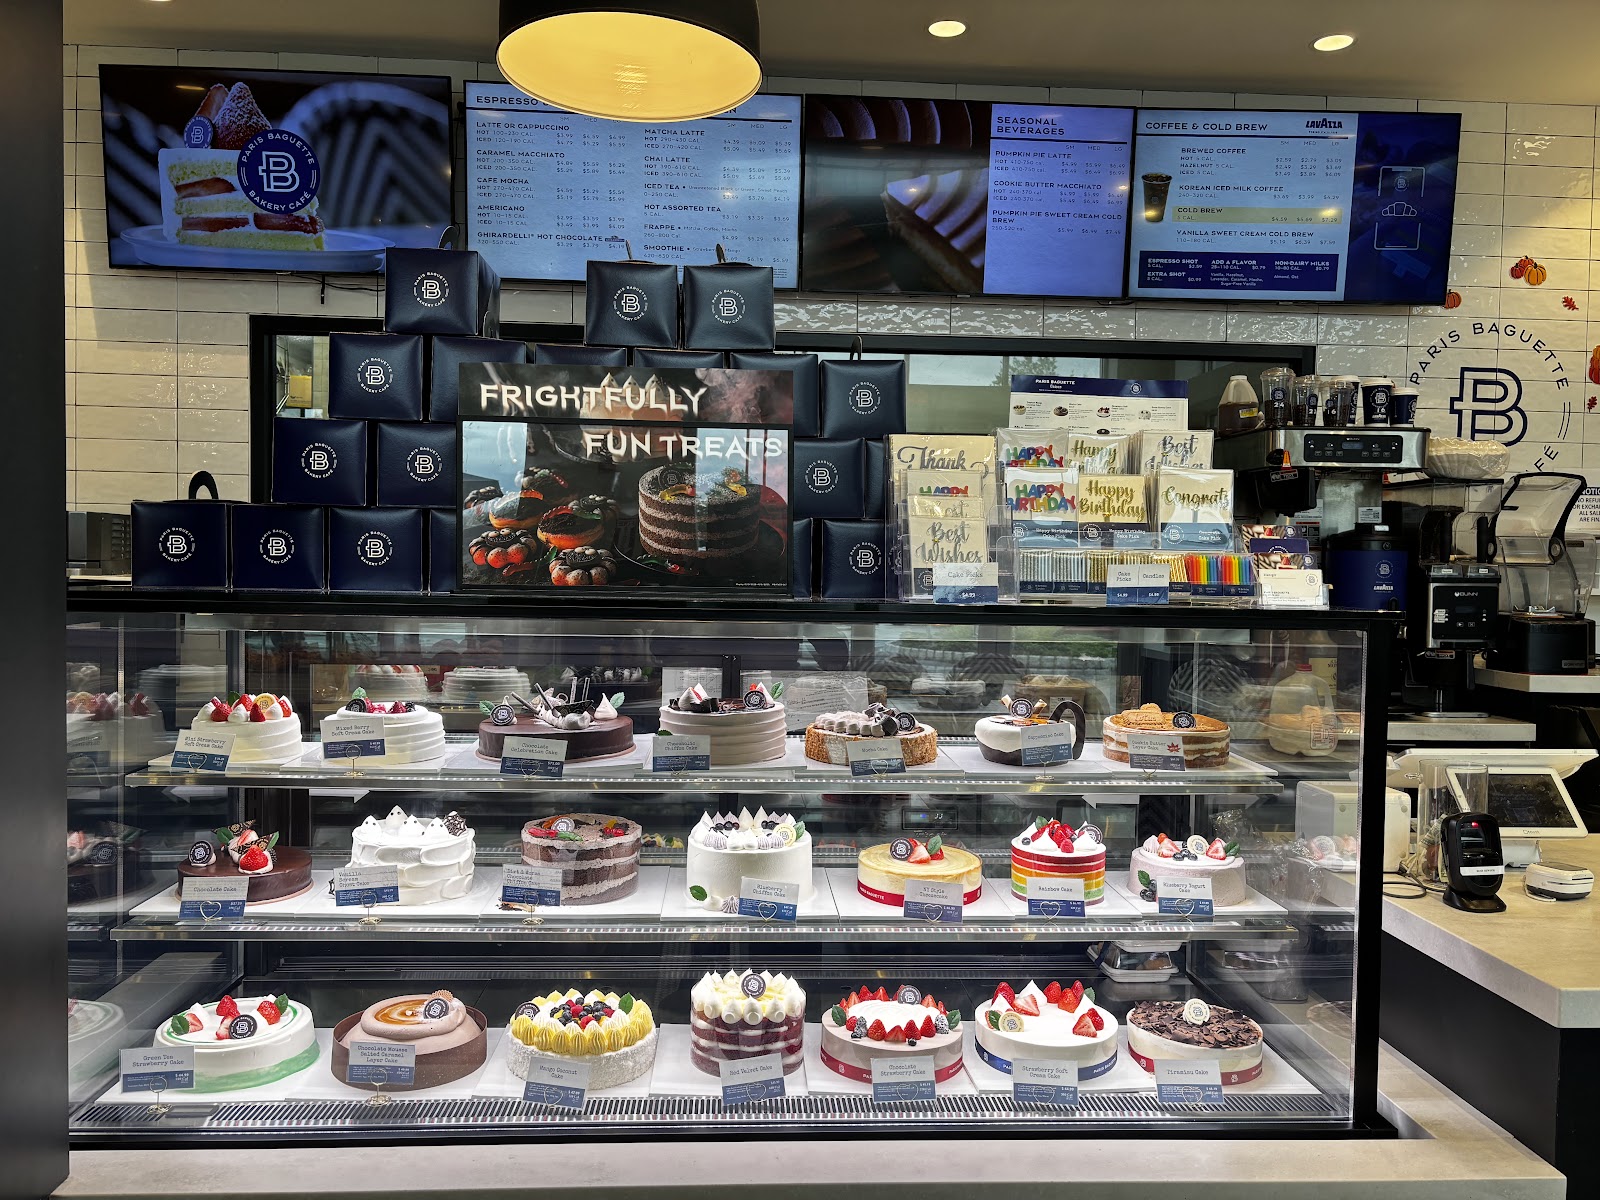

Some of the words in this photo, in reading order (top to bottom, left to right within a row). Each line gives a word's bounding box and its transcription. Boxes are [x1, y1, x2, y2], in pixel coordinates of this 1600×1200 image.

[476, 96, 539, 106] ESPRESSO
[997, 116, 1057, 126] SEASONAL
[1145, 122, 1188, 130] COFFEE
[1202, 123, 1232, 131] COLD
[1236, 123, 1268, 131] BREW
[1305, 117, 1343, 129] LAVAZZA
[997, 126, 1065, 136] BEVERAGES
[241, 136, 264, 163] PARIS
[267, 132, 316, 165] BAGUETTE
[248, 190, 286, 212] BAKERY
[288, 191, 311, 210] CAFÉ
[555, 234, 603, 242] CHOCOLATE
[1409, 330, 1461, 385] PARIS
[1472, 322, 1569, 390] BAGUETTE
[480, 383, 708, 416] FRIGHTFULLY
[583, 432, 651, 459] FUN
[658, 435, 783, 462] TREATS
[1006, 444, 1054, 460] HAPPY
[1070, 440, 1120, 464] Happy
[1158, 435, 1199, 458] Best
[897, 446, 967, 470] Thank
[1015, 482, 1065, 498] HAPPY
[1085, 479, 1136, 499] Happy
[1007, 496, 1077, 514] BIRTHDAY
[1079, 498, 1146, 522] Birthday
[926, 521, 970, 544] Best
[915, 542, 984, 564] Wishes
[197, 737, 227, 745] Strawberry
[522, 742, 549, 750] Chocolate
[1038, 885, 1060, 893] Rainbow
[132, 1060, 168, 1068] Strawberry
[366, 1056, 382, 1064] Layer
[741, 1066, 759, 1075] Velvet
[760, 1064, 772, 1072] Cake
[880, 1069, 912, 1077] Strawberry
[1022, 1066, 1054, 1074] Strawberry
